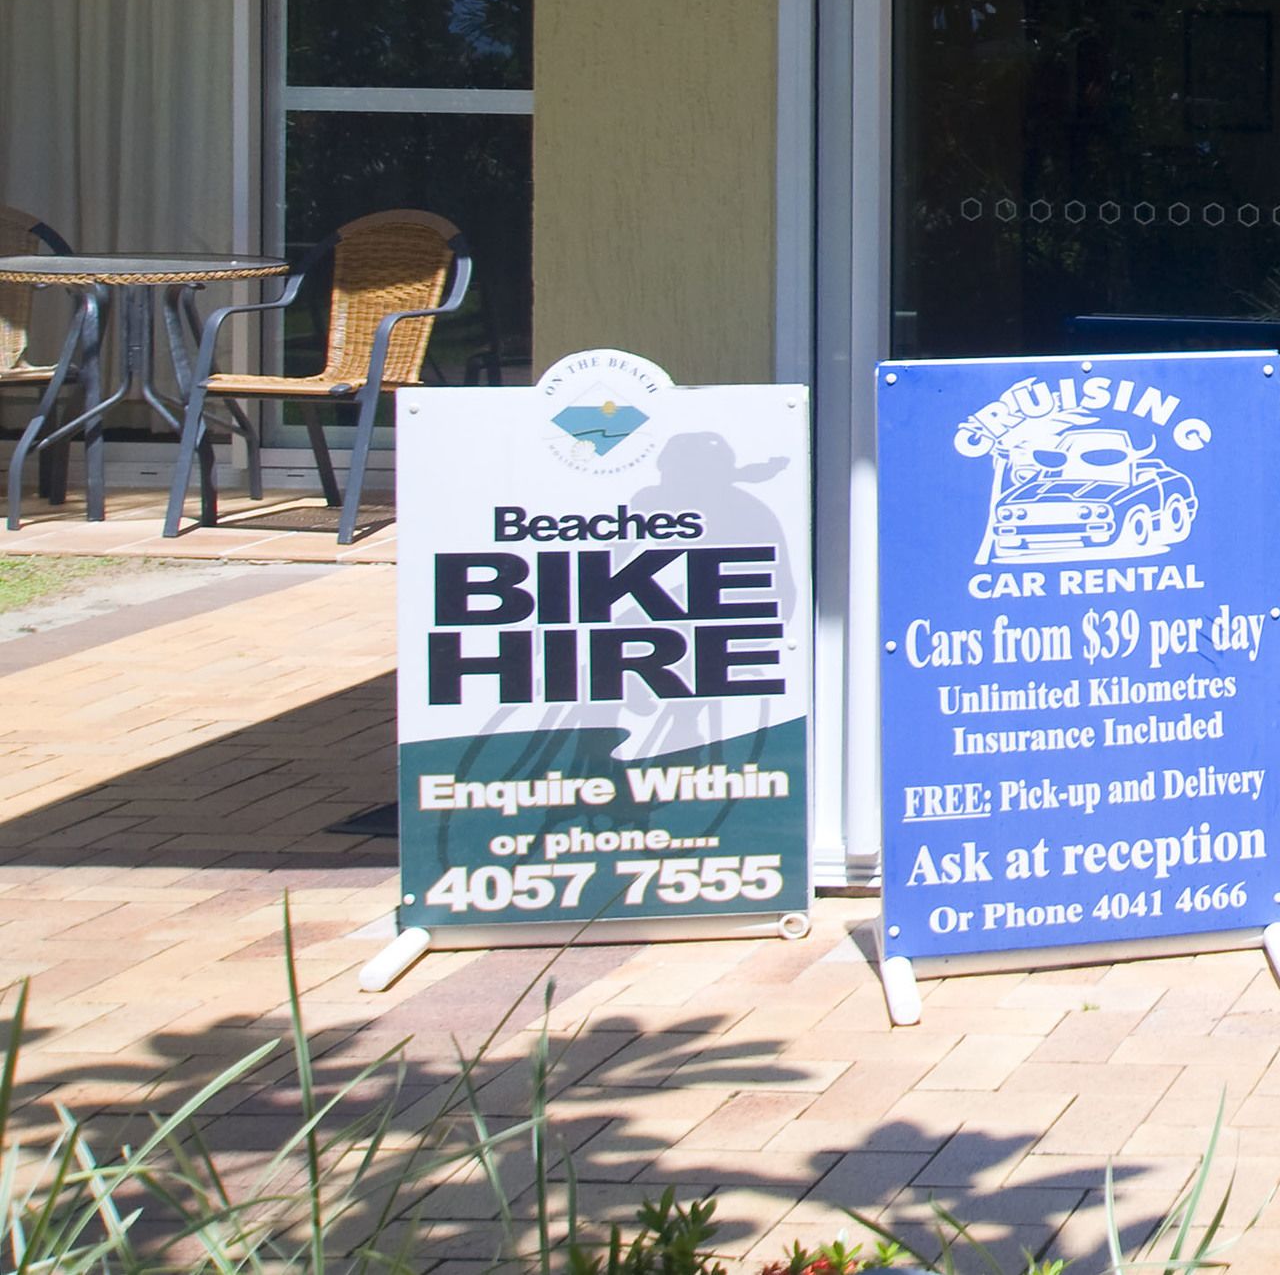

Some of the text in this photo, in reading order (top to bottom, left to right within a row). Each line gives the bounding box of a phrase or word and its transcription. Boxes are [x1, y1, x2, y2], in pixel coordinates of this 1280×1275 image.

[545, 357, 658, 396] ON THE BEACH
[953, 376, 1212, 458] CRUISING
[494, 505, 704, 543] Beaches
[434, 545, 780, 626] BIKE
[968, 565, 1205, 599] CAR RENTAL
[905, 605, 1265, 669] Cars from $39 per day
[428, 623, 786, 705] HIRE
[938, 674, 1237, 715] Unlimited Kilometres
[953, 711, 1224, 756] Insurance Included
[418, 764, 789, 814] Enquire Within
[902, 767, 1265, 822] FREE: Pick-up and Delivery
[490, 826, 720, 860] or phone....
[906, 822, 1266, 886] Ask at reception
[426, 855, 784, 911] 4057 7555
[929, 882, 1248, 933] Or Phone 4041 4666
